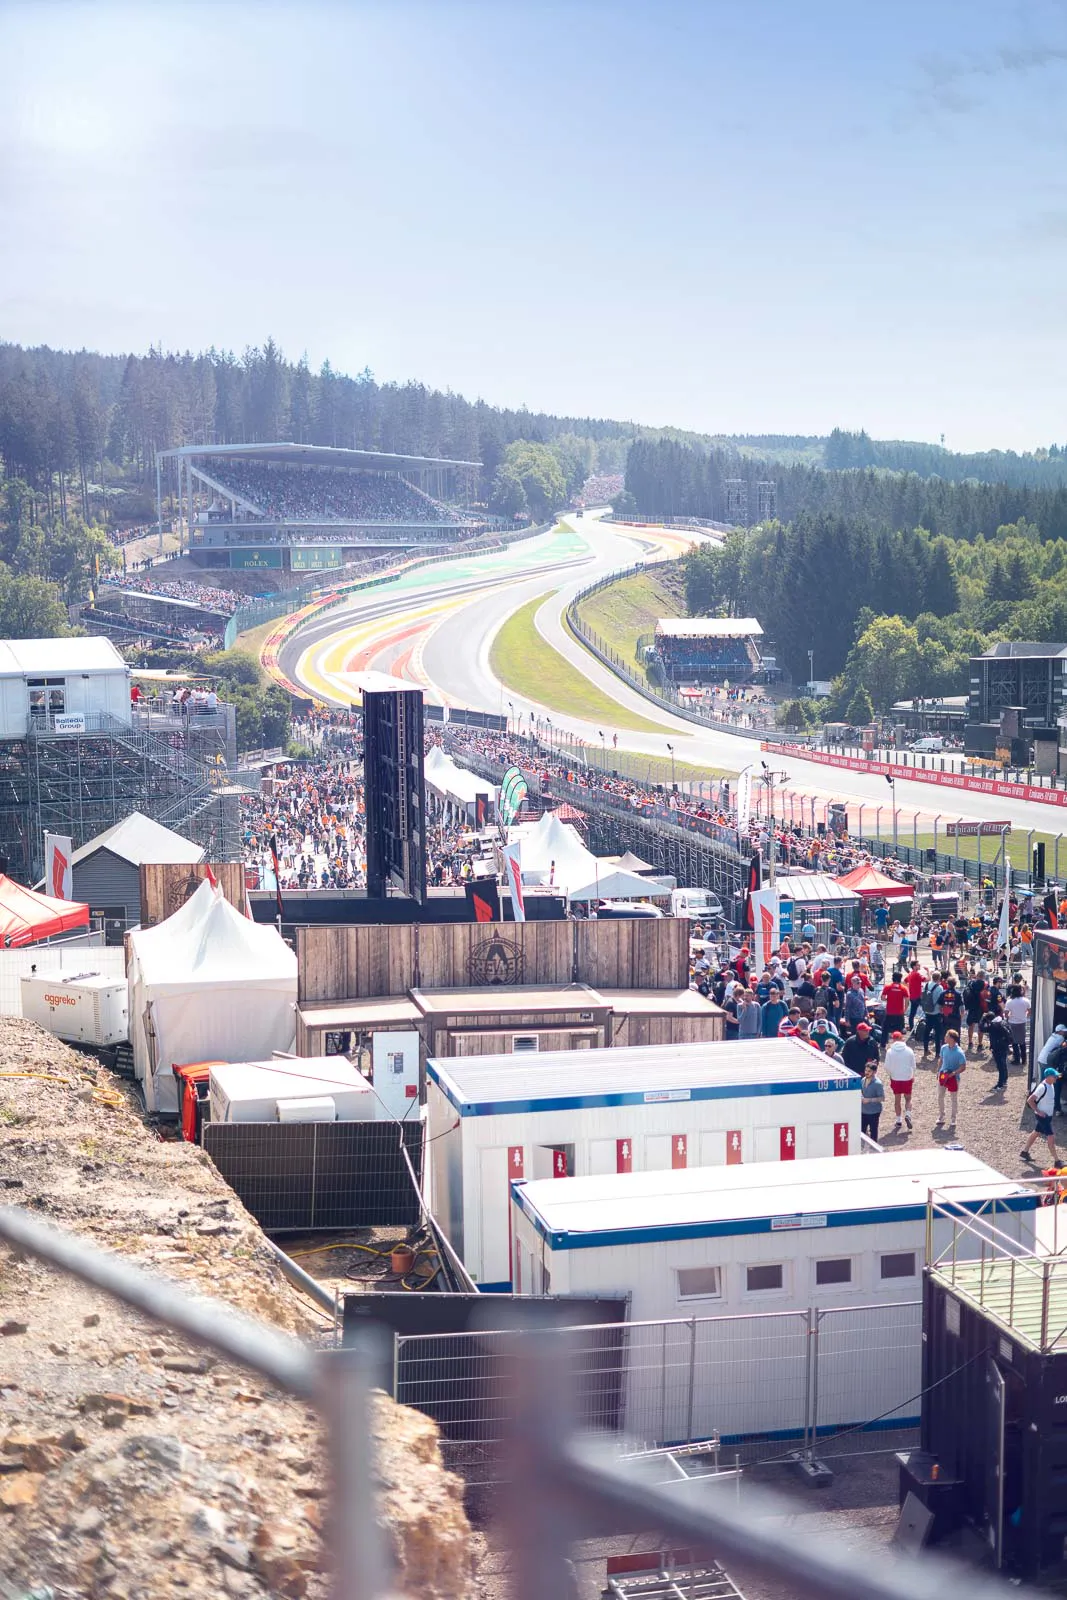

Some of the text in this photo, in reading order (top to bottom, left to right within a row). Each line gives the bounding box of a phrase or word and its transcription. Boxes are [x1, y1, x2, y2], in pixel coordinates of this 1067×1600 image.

[244, 560, 269, 568] ROLEX
[44, 994, 76, 1006] aggreko
[818, 1078, 849, 1090] 09 101
